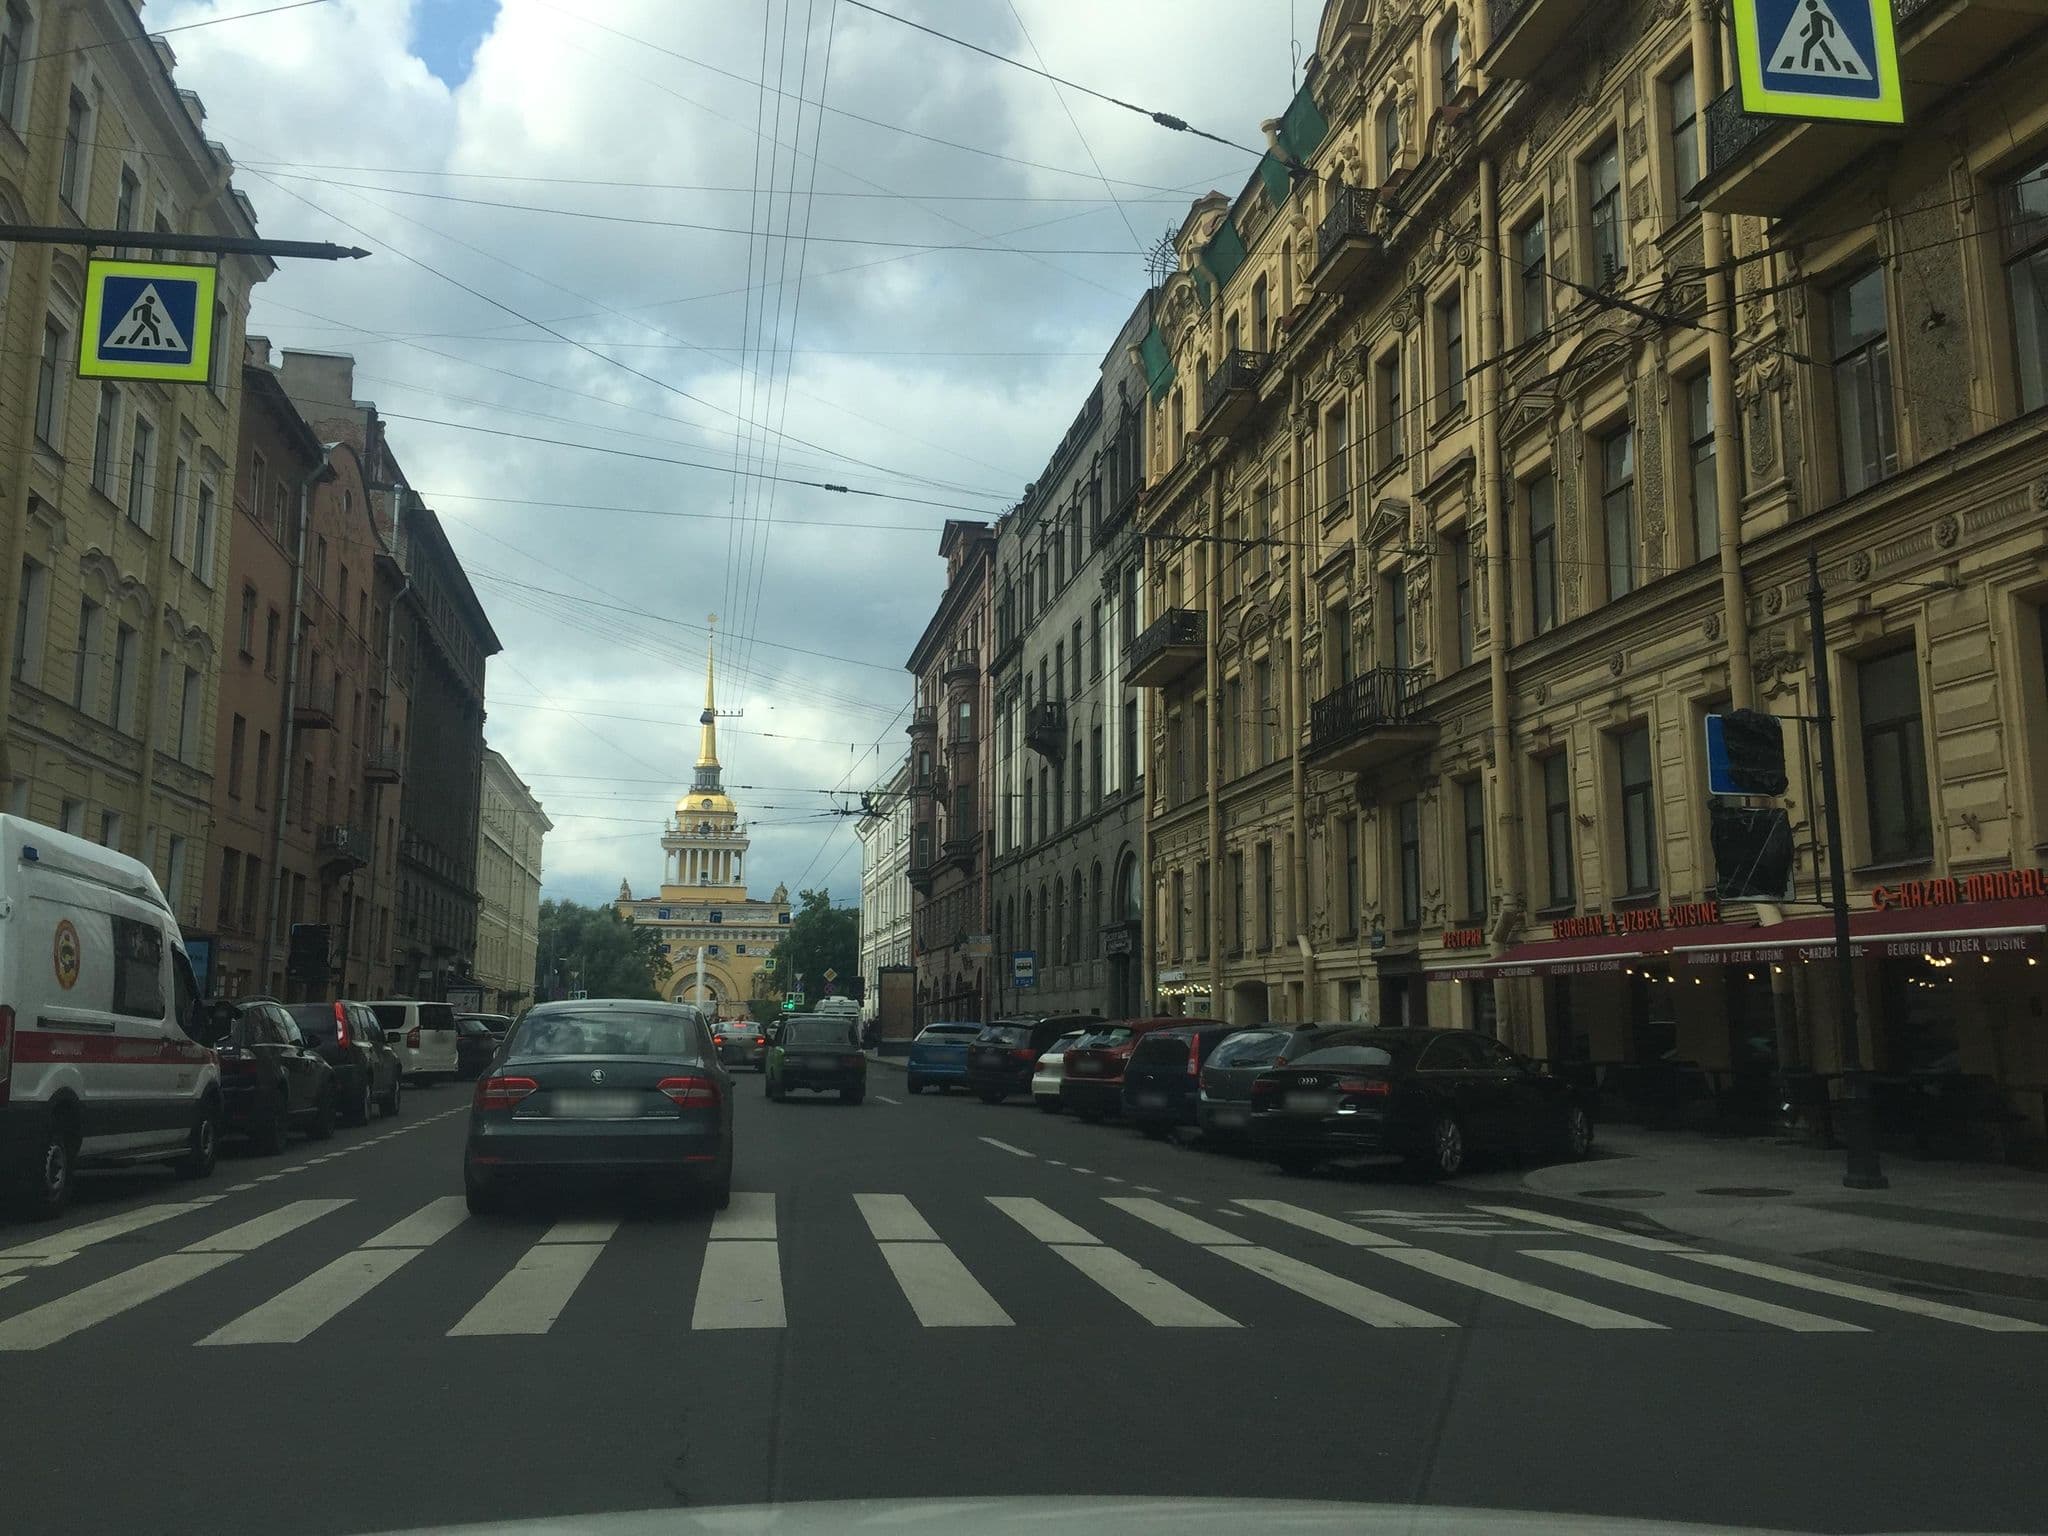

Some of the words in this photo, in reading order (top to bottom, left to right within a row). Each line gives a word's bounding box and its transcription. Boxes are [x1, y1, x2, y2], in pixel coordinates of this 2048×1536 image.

[1551, 915, 1603, 938] GEORGIAN
[1608, 912, 1617, 934] &
[1622, 909, 1661, 932] UZBEK
[1667, 902, 1719, 927] CUISINE
[1887, 941, 1932, 956] GEORGIAN
[1937, 941, 1944, 954] &
[1949, 938, 1981, 953] UZBEK
[1985, 936, 2027, 952] CUISINE
